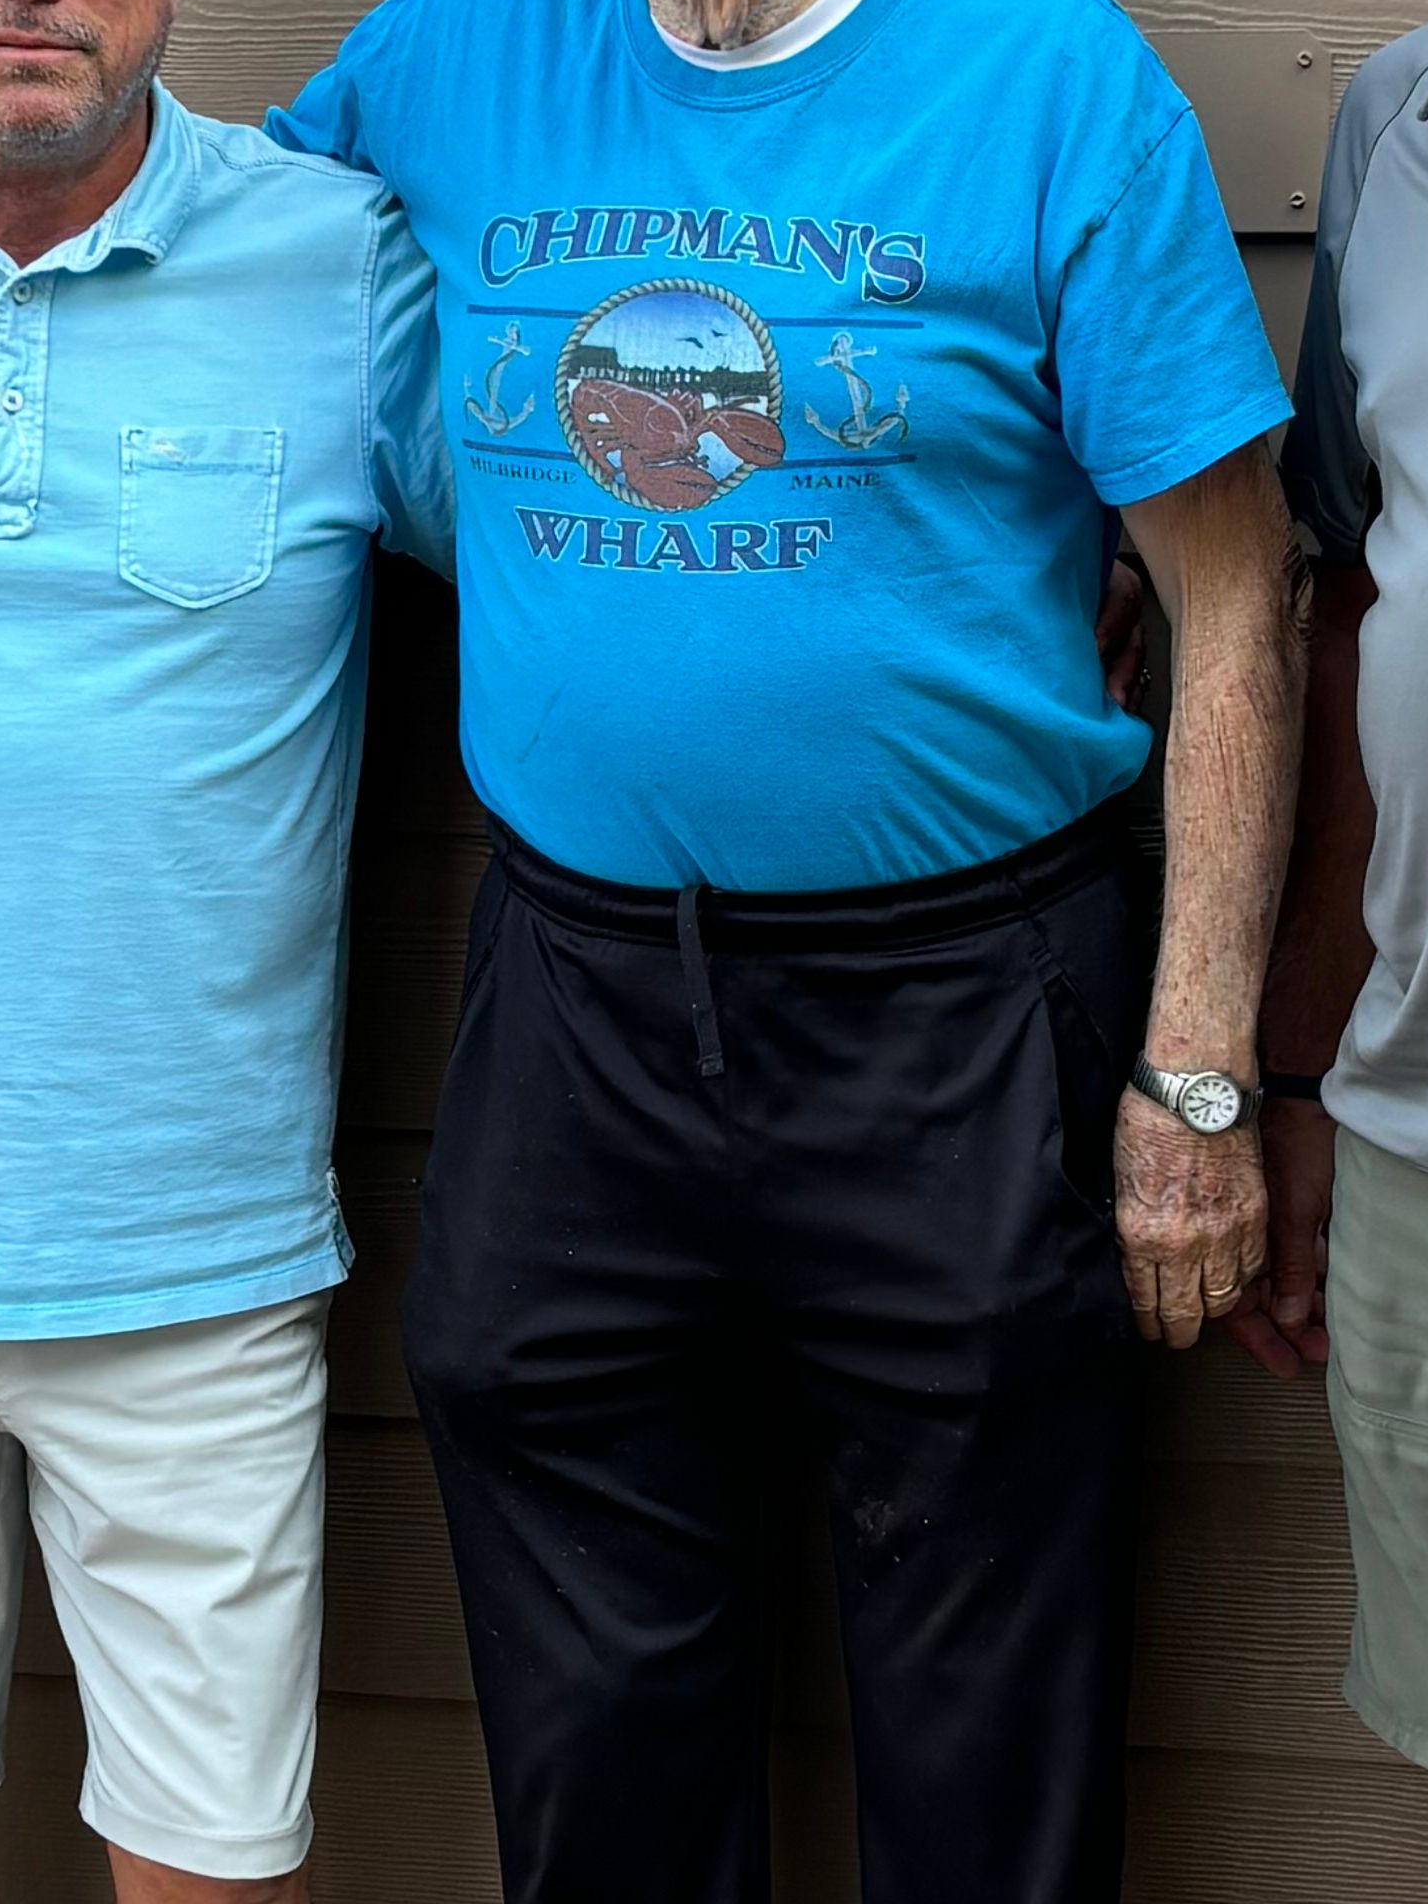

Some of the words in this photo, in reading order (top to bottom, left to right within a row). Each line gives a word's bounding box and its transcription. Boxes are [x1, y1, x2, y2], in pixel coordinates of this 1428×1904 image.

[480, 205, 927, 304] CHIPMAN'S
[790, 473, 883, 493] MAINE
[515, 506, 832, 574] WHARF
